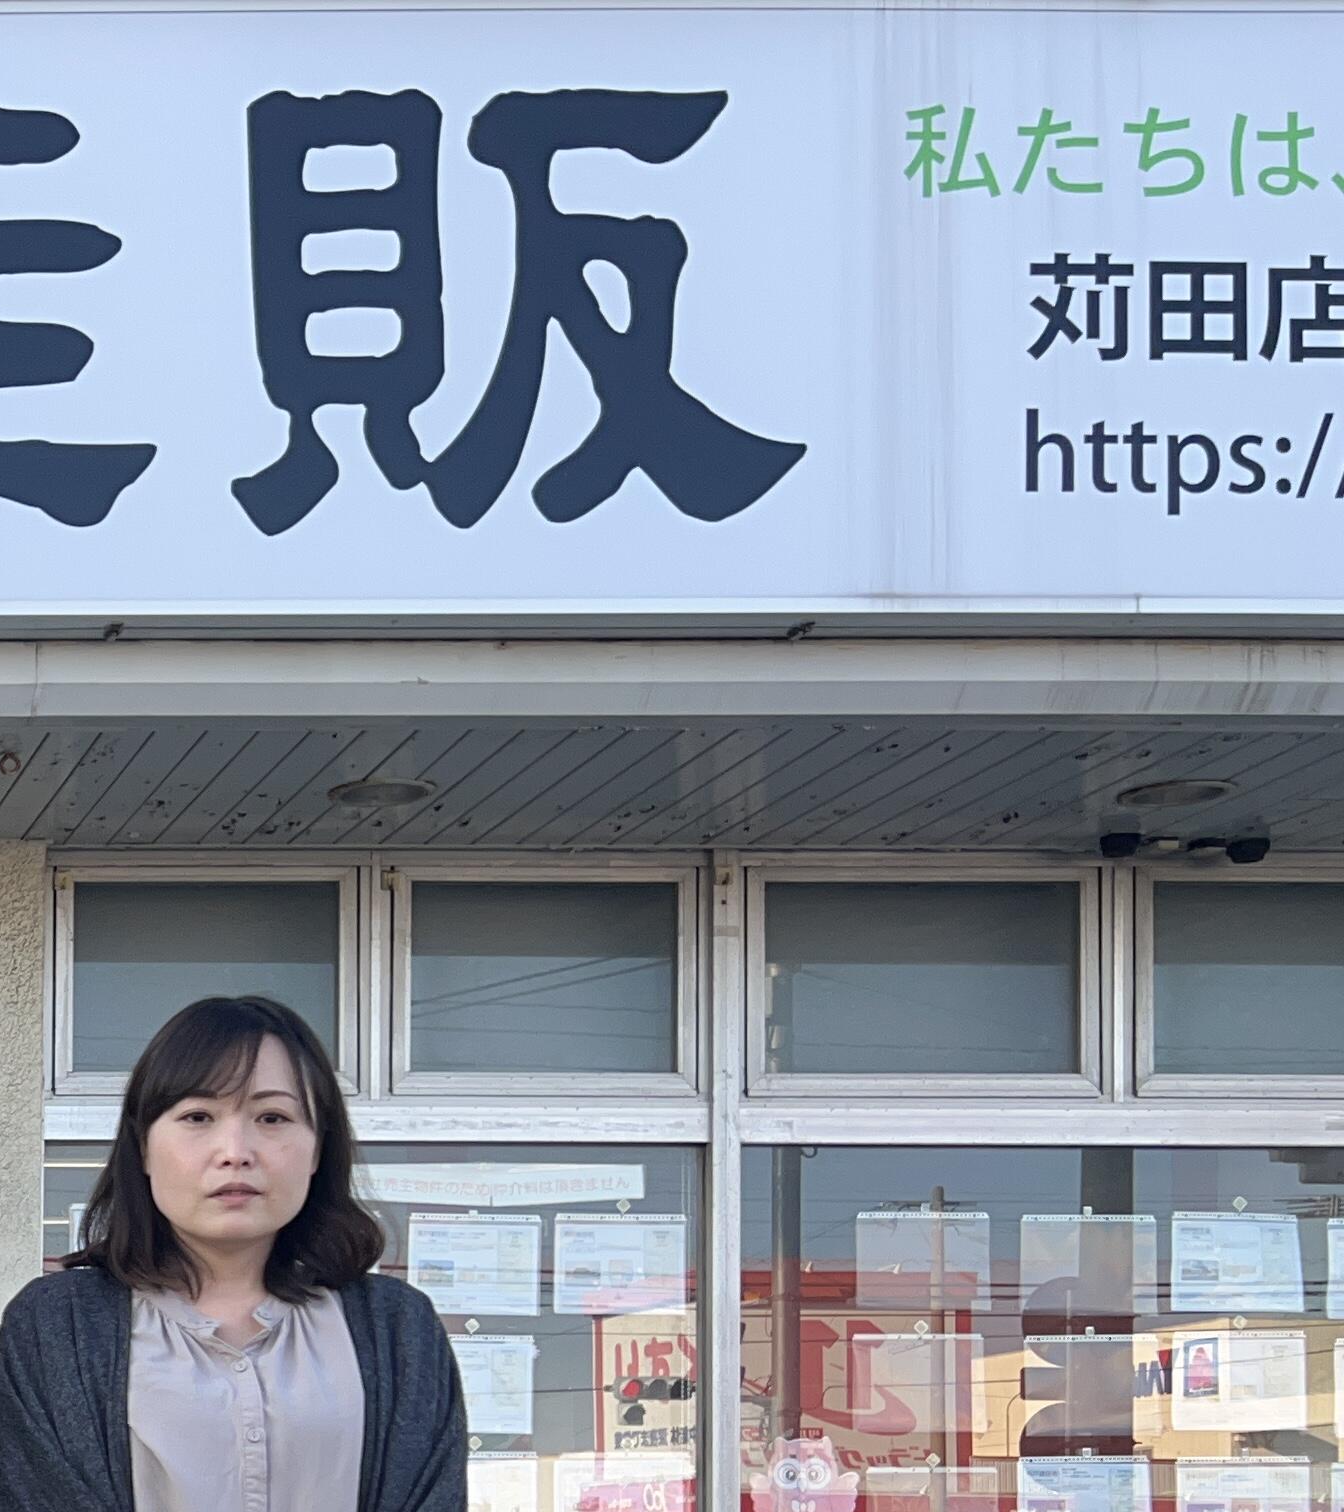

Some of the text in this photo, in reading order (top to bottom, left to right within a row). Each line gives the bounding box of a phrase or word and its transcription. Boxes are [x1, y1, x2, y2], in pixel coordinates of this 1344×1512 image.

[1026, 253, 1344, 362] 苅田店
[1025, 408, 1344, 516] https:/
